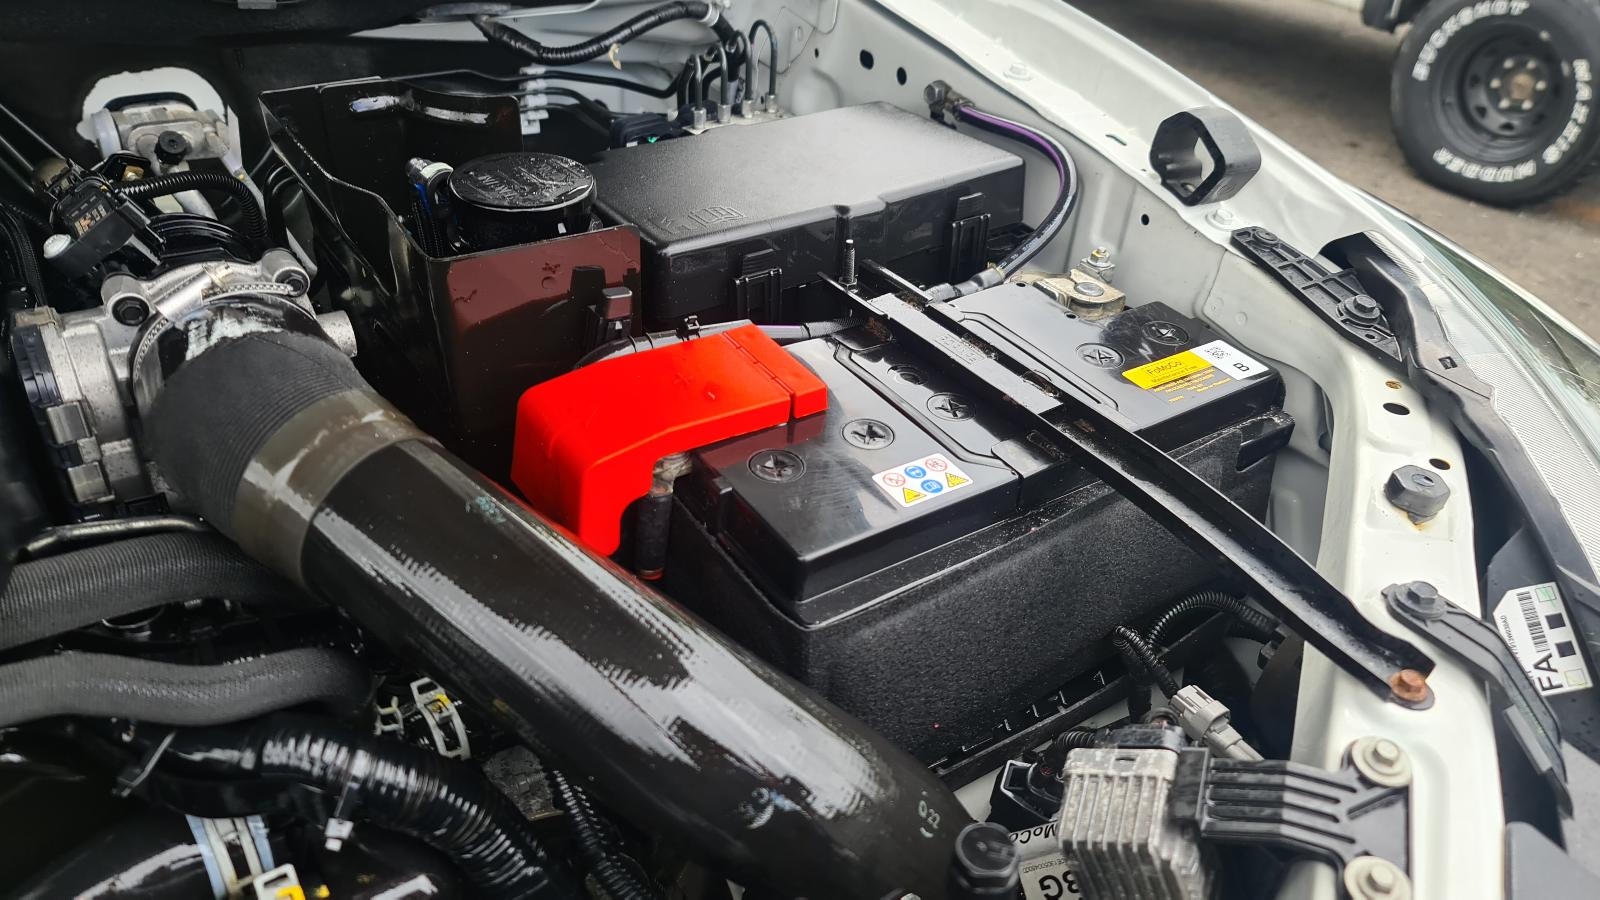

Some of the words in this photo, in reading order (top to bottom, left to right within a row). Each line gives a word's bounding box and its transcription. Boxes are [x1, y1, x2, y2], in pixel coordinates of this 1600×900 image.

[1542, 58, 1593, 165] MAXXIS
[1433, 147, 1537, 182] MUDDER
[1147, 362, 1183, 375] FoMoCo
[1233, 363, 1250, 372] B
[1533, 653, 1564, 692] FA
